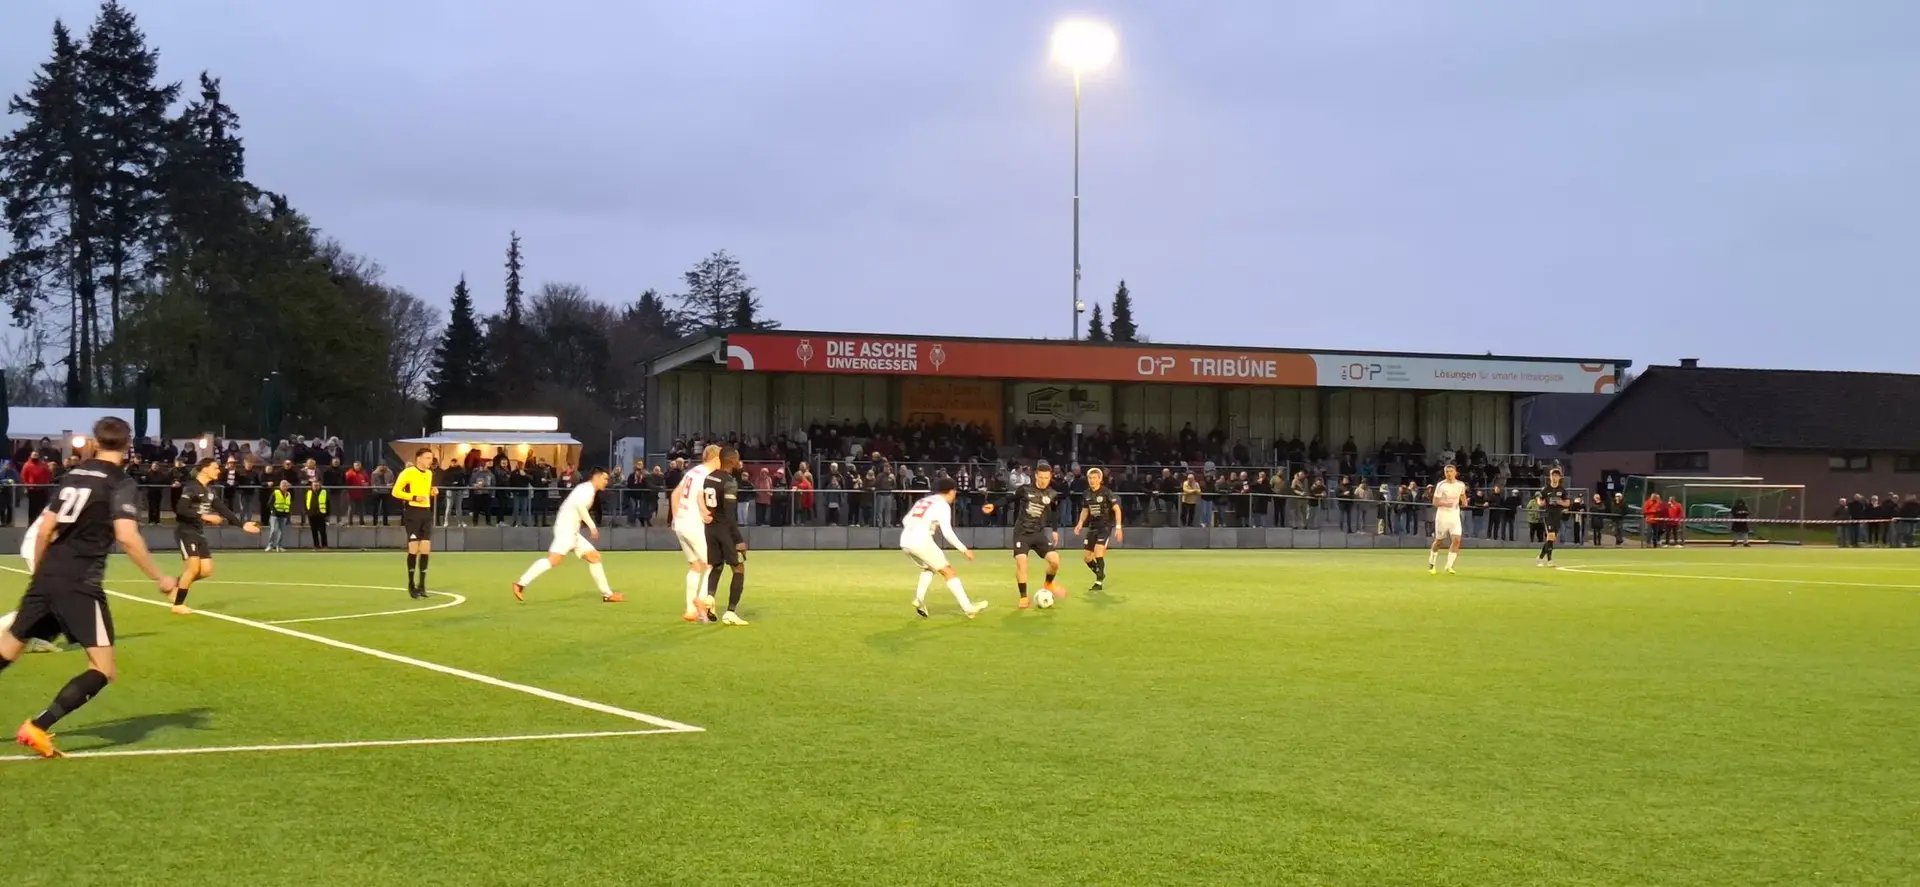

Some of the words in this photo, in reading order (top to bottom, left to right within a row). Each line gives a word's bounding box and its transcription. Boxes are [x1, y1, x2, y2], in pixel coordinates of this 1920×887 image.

[826, 341, 857, 356] DIE
[859, 342, 918, 359] ASCHE
[826, 357, 918, 371] UNVERGESSEN
[1190, 356, 1277, 378] TRIBÜNE
[1434, 369, 1477, 381] Lösungen
[1491, 373, 1518, 381] smarte
[57, 486, 92, 523] 21
